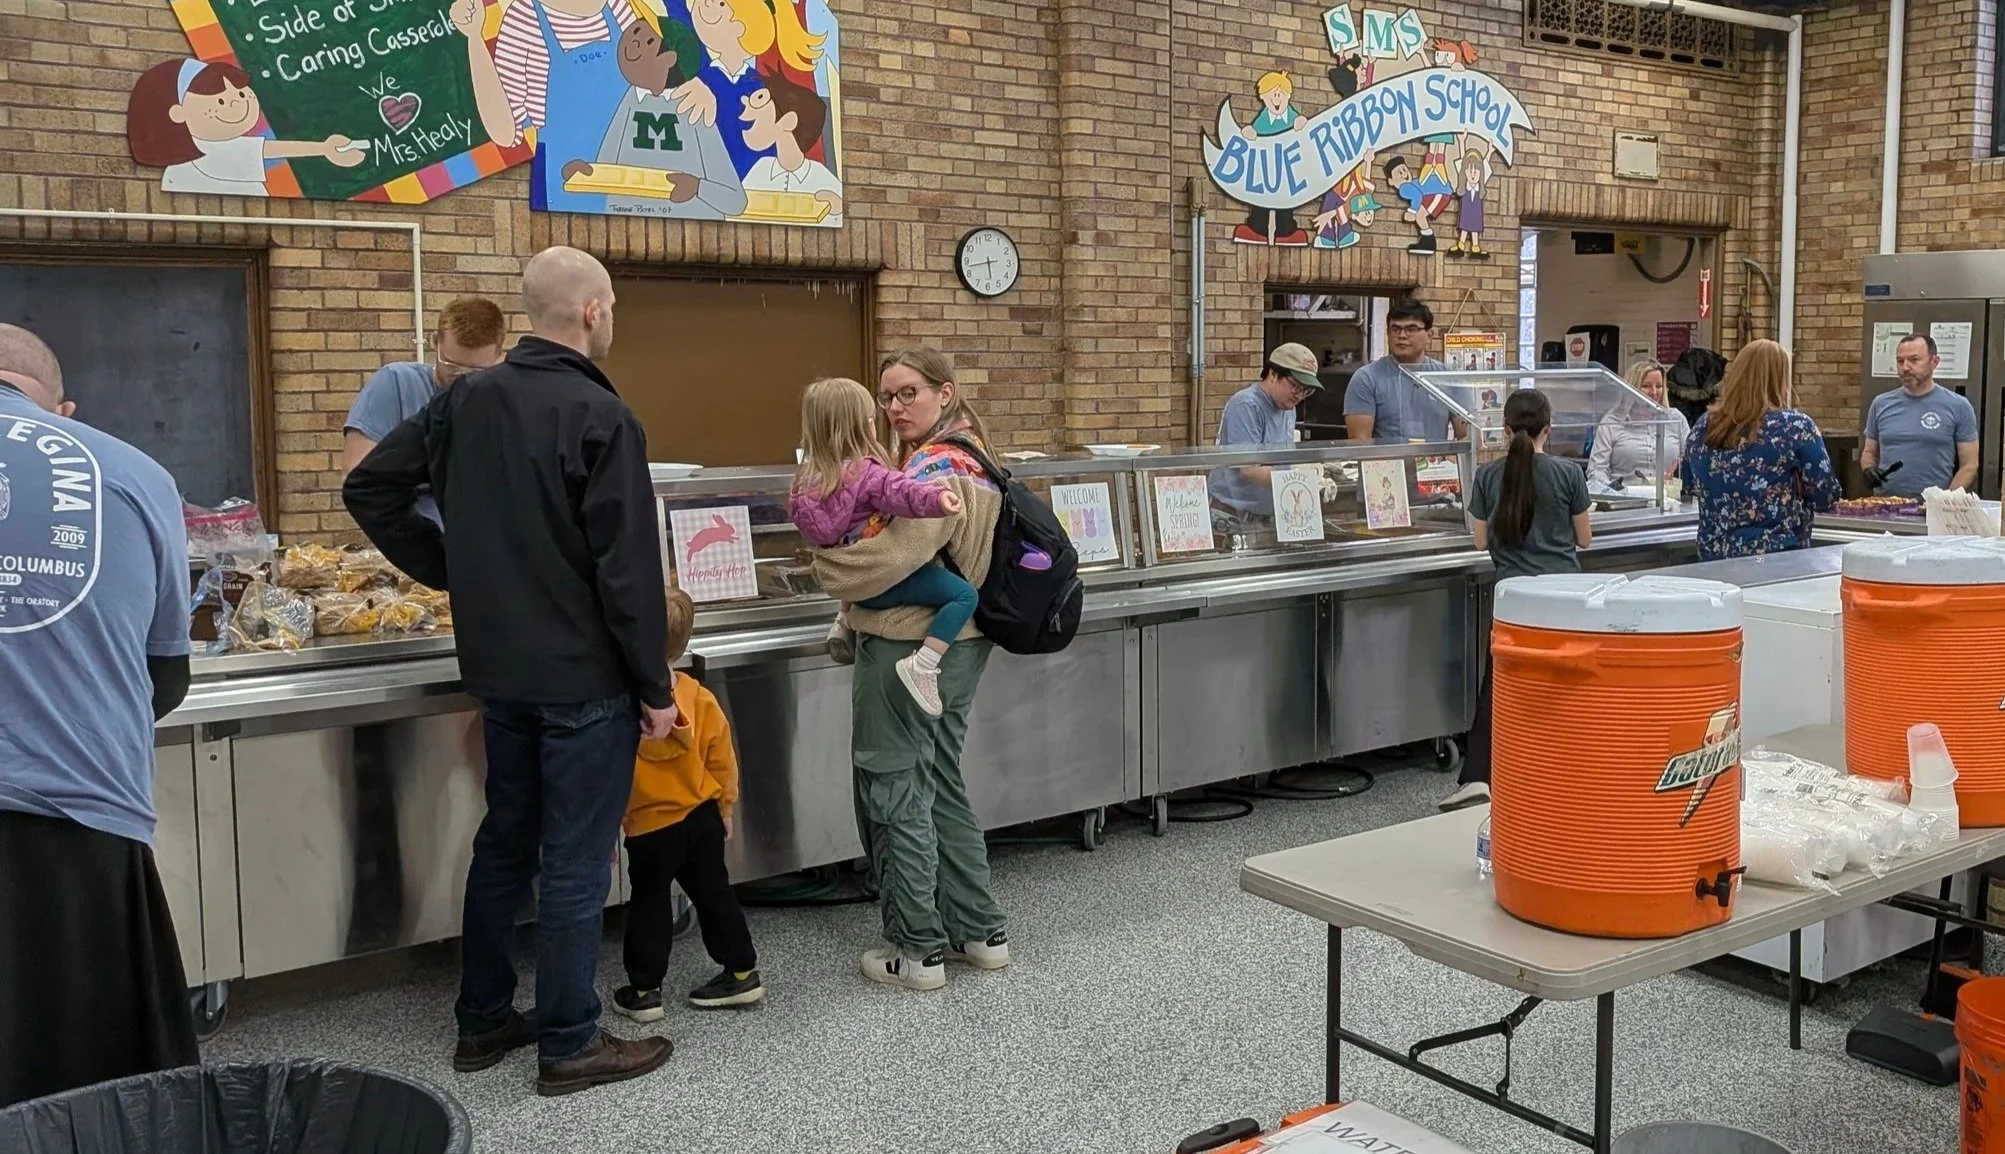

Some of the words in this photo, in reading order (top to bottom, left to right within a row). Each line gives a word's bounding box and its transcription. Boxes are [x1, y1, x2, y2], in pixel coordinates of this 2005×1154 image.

[258, 5, 326, 44] Side
[276, 43, 366, 81] Caring
[358, 72, 400, 99] We
[632, 110, 683, 151] M
[1212, 134, 1308, 196] BLUE
[1424, 73, 1512, 148] SCHOOL
[0, 420, 92, 512] EGINA
[1061, 487, 1100, 505] WELCOME
[53, 529, 86, 545] 2009
[0, 555, 85, 578] OLUMBUS
